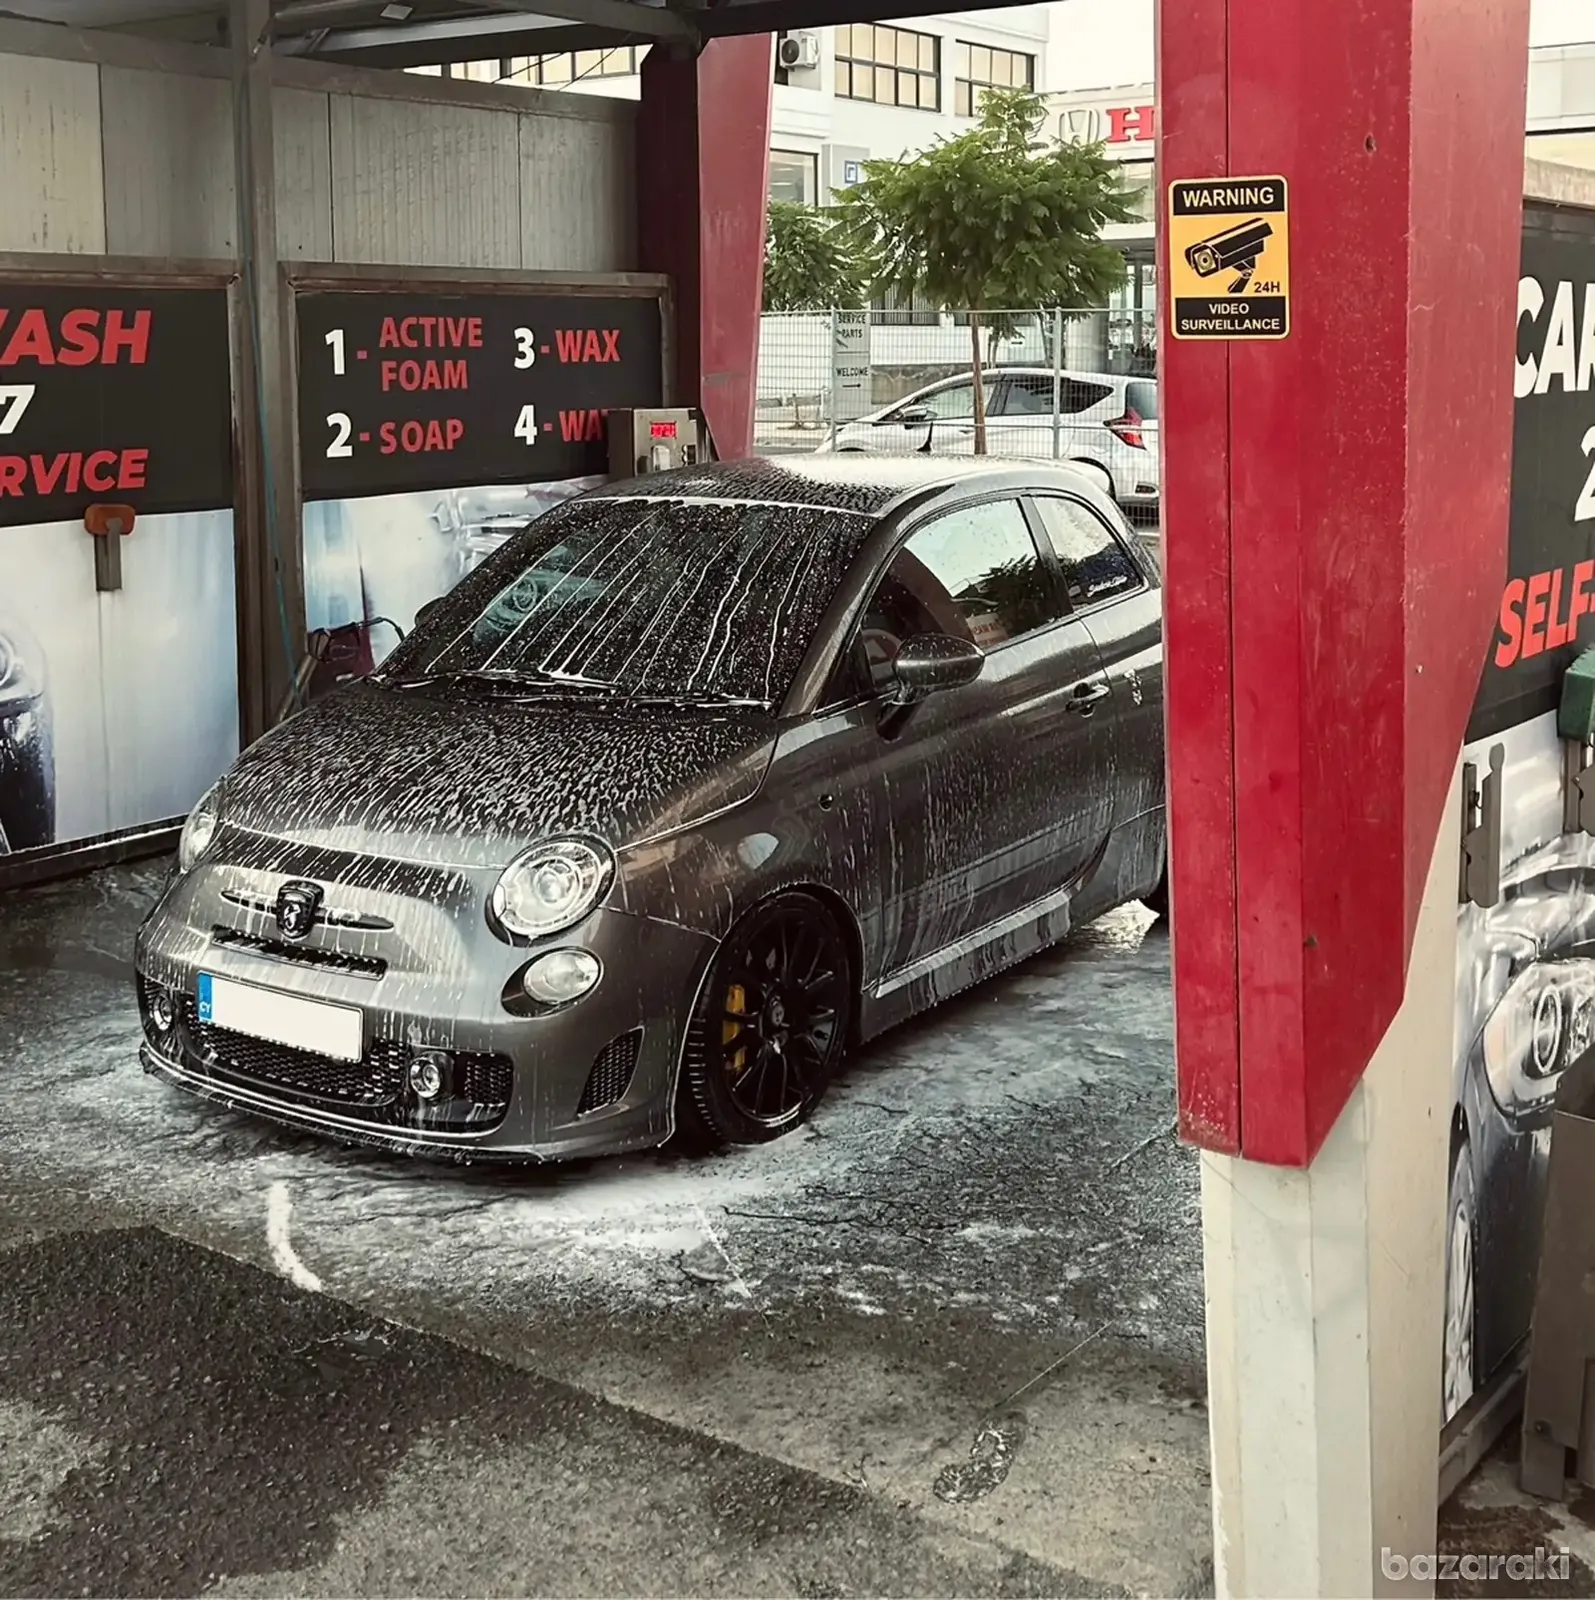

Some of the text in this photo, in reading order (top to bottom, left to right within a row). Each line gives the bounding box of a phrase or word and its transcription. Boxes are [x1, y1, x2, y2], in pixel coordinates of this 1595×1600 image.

[1182, 187, 1274, 207] WARNING
[1254, 281, 1280, 293] 24H
[1209, 303, 1249, 314] VIDEO
[838, 313, 866, 324] SERVICE
[1181, 318, 1280, 330] SURVEILLANCE
[0, 308, 151, 365] ASH
[841, 329, 862, 338] PARTS
[325, 329, 345, 375] 1
[379, 317, 483, 349] ACTIVE
[381, 360, 469, 392] FOAM
[836, 367, 868, 376] WELCOME
[559, 408, 608, 442] WA
[326, 412, 353, 458] 2
[380, 418, 464, 454] SOAP
